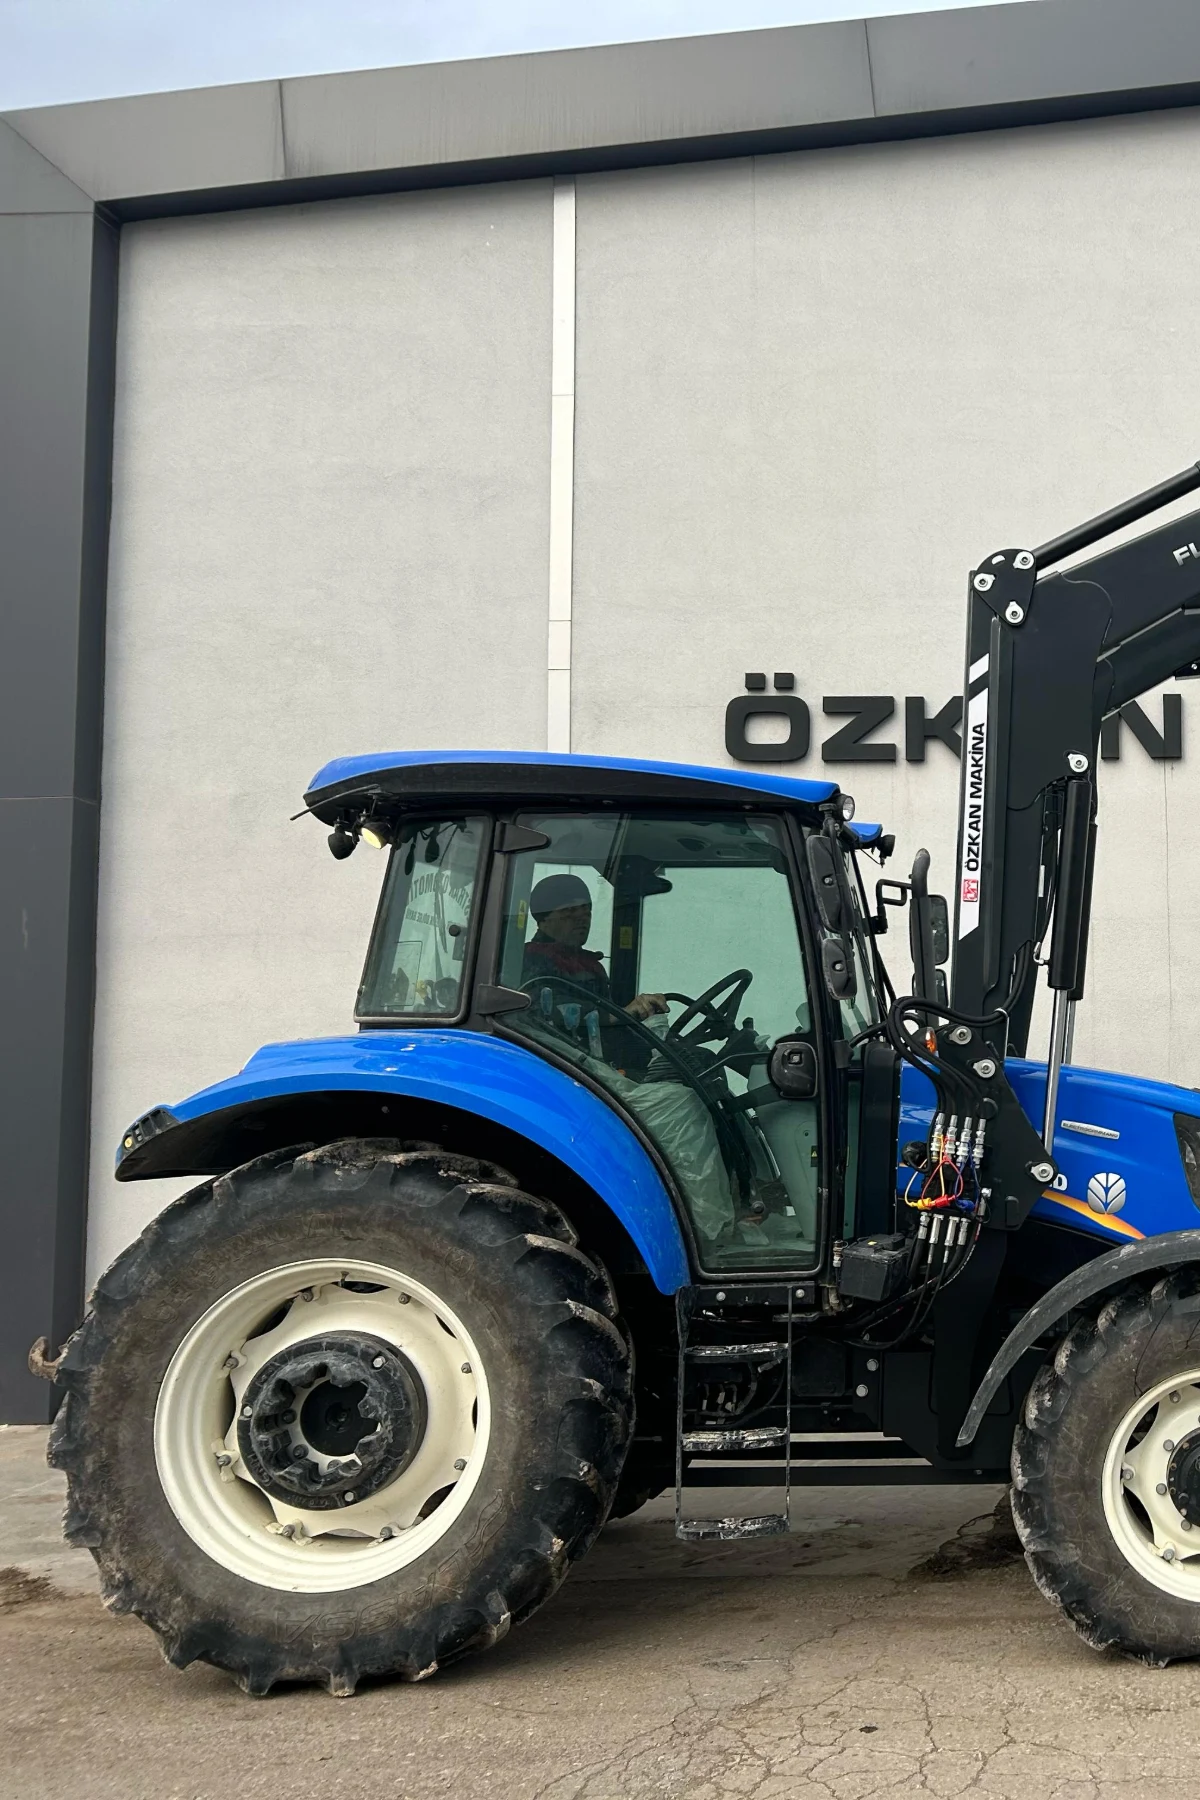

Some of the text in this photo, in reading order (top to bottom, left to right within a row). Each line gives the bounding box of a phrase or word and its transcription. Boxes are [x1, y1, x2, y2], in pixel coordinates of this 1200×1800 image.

[725, 672, 1182, 762] ÖZKN
[964, 722, 985, 872] ÖZKAN MAKİNA
